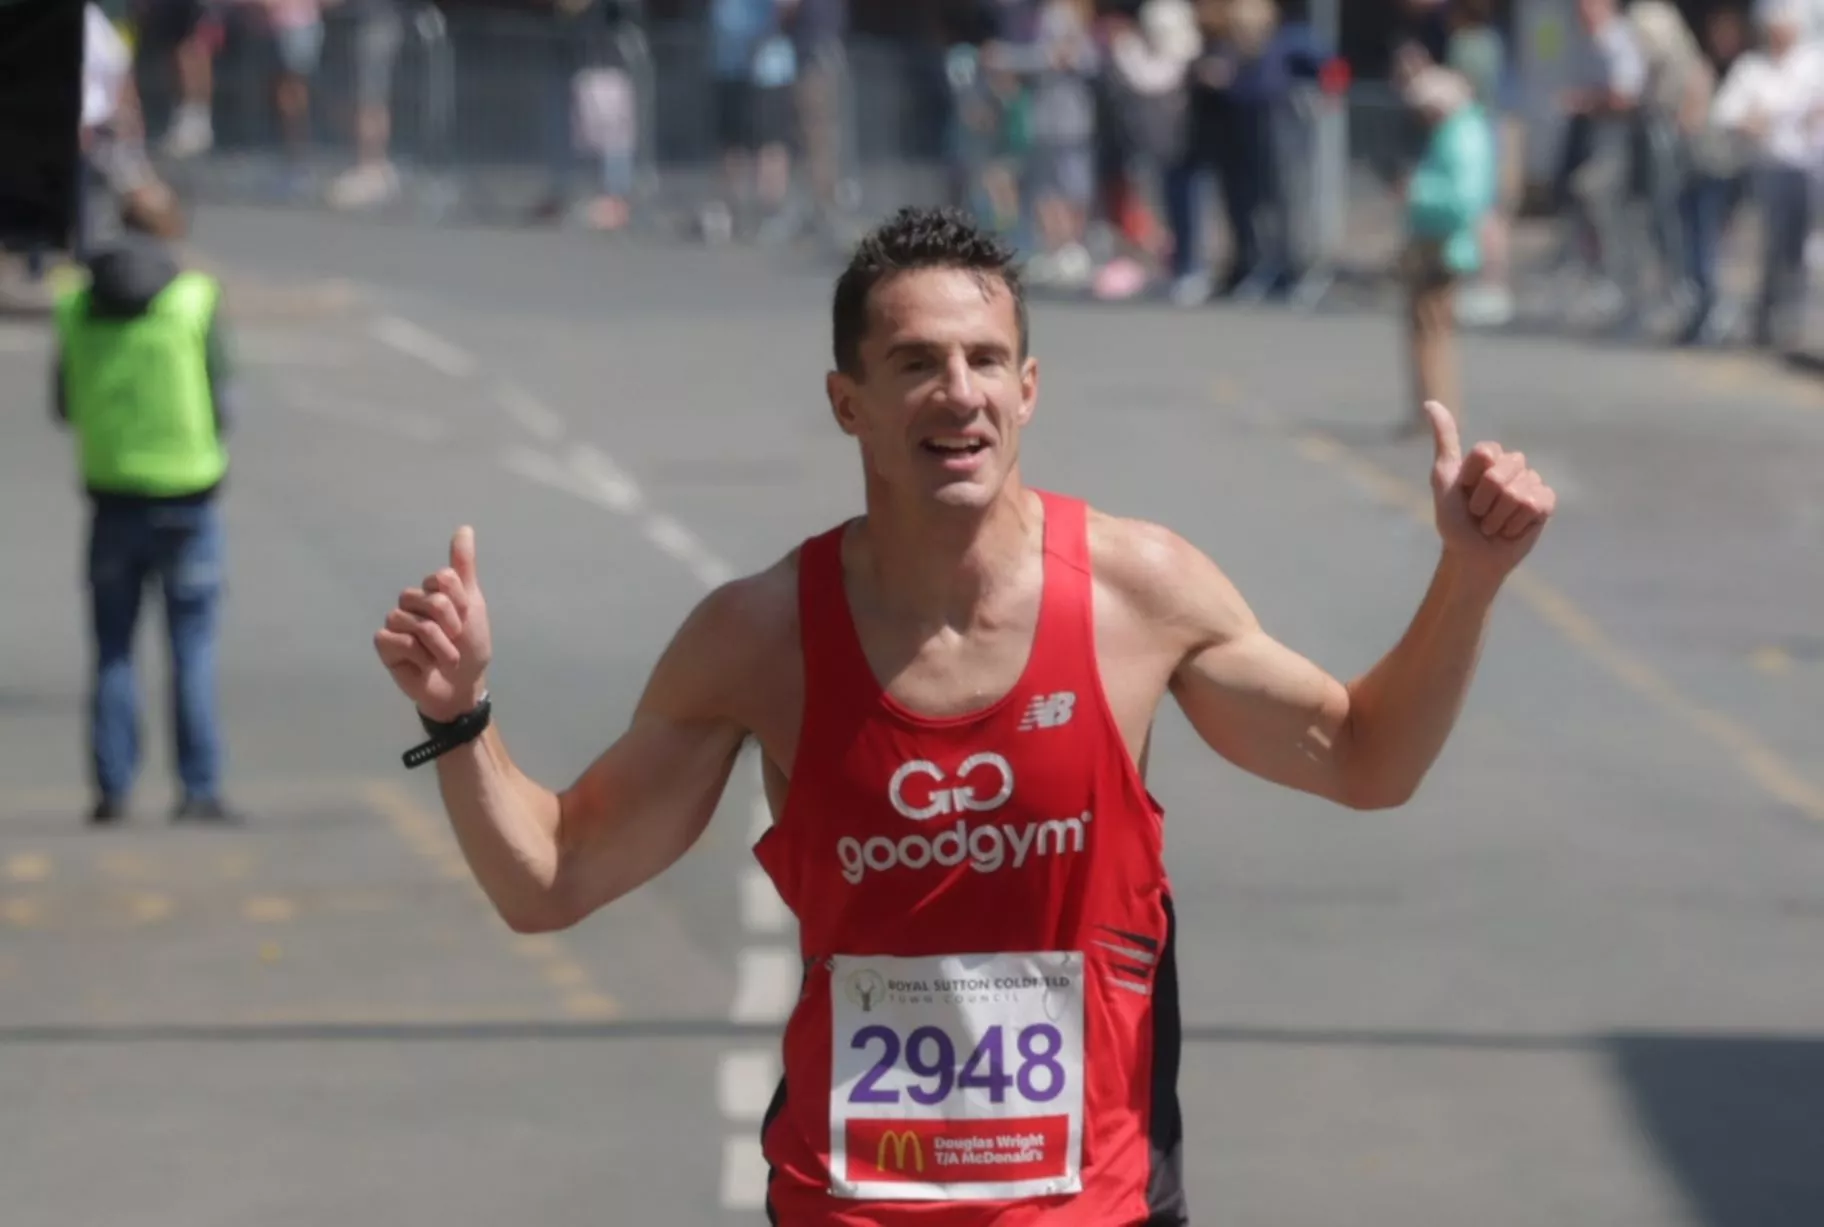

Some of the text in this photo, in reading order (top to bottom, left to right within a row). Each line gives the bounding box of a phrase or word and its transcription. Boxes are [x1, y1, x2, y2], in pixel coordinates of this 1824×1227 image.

[837, 815, 1085, 885] goodgym
[888, 979, 928, 992] ROYAL
[933, 979, 989, 991] SUTTON
[848, 1023, 1066, 1105] 2948
[934, 1133, 1044, 1152] Douglas Wright
[934, 1150, 1043, 1167] T/A McDonald's
